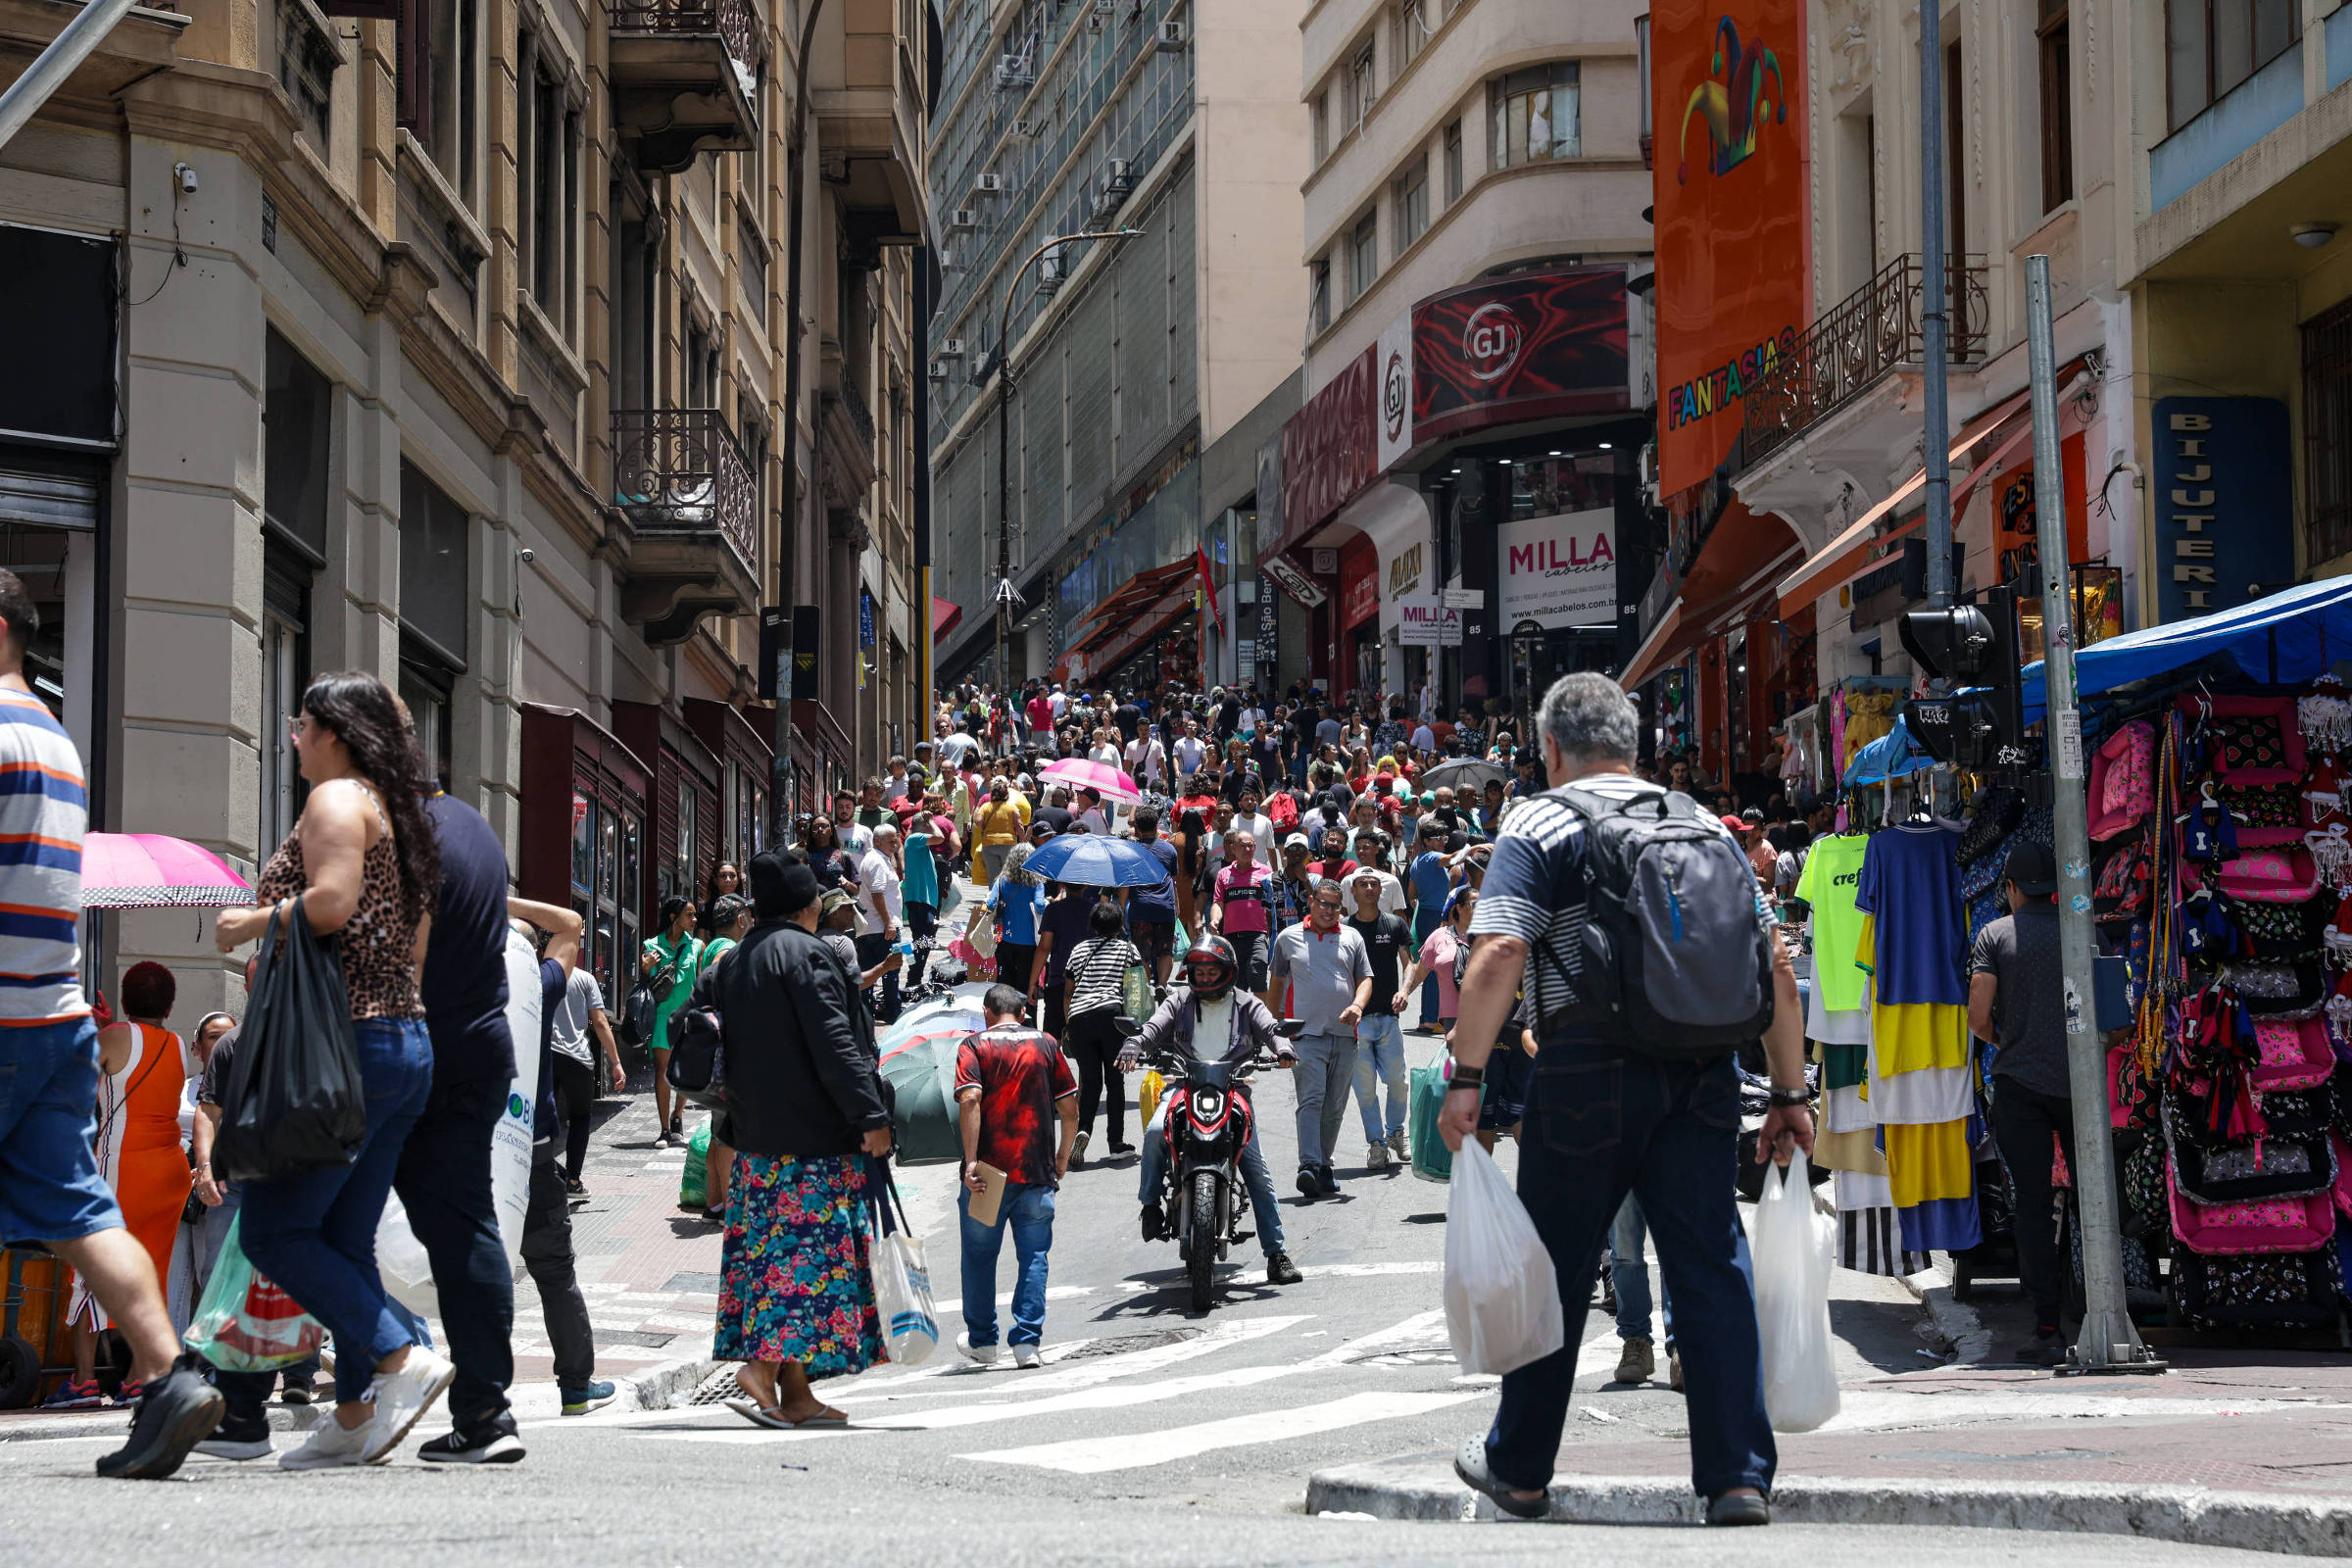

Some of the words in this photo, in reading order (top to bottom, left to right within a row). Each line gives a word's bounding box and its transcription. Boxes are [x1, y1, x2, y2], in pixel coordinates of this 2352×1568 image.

[1473, 324, 1505, 359] GJ
[1669, 325, 1796, 431] FANTASIAS
[1388, 374, 1400, 413] GJ
[2170, 414, 2217, 619] BIJUTERI
[1509, 532, 1615, 575] MILLA
[1544, 556, 1615, 578] cabelos
[1261, 575, 1273, 604] Ben
[1261, 607, 1272, 631] São
[1404, 606, 1458, 622] MILLA
[1624, 605, 1637, 614] 85
[1469, 625, 1481, 634] 85
